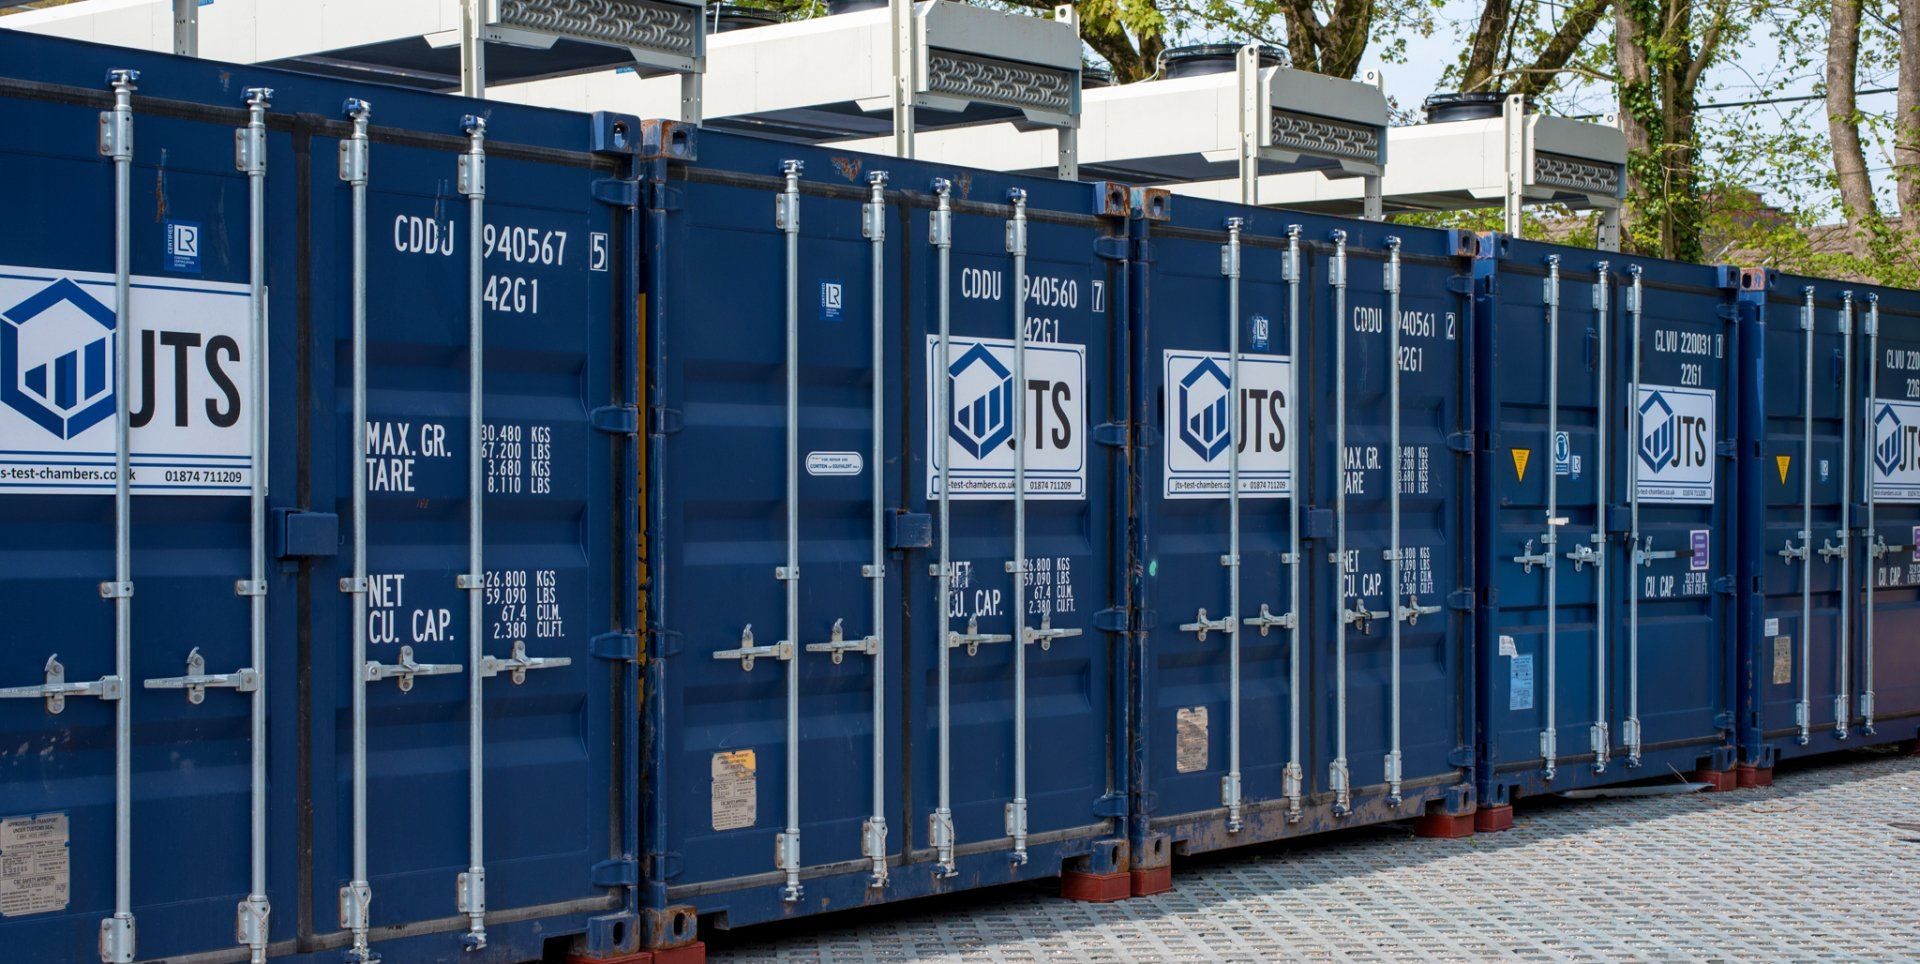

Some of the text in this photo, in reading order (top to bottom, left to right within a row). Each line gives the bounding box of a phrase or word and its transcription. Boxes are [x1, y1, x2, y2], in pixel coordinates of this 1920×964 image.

[177, 227, 196, 254] LR
[483, 224, 567, 266] 940567
[591, 233, 606, 270] 5
[483, 275, 538, 314] 42G1
[962, 267, 1103, 311] CDDU 940560 7
[1354, 306, 1454, 338] CDDU 40561 2
[1655, 330, 1677, 353] CLVU
[1681, 332, 1711, 356] 220031
[1906, 350, 1920, 370] 220
[129, 329, 241, 428] JTS
[1681, 363, 1702, 386] 22G1
[1238, 389, 1286, 454] JTS
[366, 422, 451, 457] MAX. GR.
[531, 426, 550, 443] KGS
[1670, 415, 1706, 468] JTS
[531, 443, 550, 460] LBS
[1366, 447, 1381, 470] GR.
[1899, 425, 1920, 472] JT
[165, 470, 200, 482] 01874
[203, 471, 242, 483] 711209
[366, 458, 415, 492] TARE
[531, 460, 550, 477] KGS
[531, 477, 550, 494] LBS
[1030, 481, 1048, 490] 01874
[1050, 481, 1072, 490] 711209
[1057, 557, 1070, 571] KGS
[536, 570, 555, 587] KGS
[1057, 571, 1070, 585] LBS
[1363, 573, 1383, 597] CAP.
[1660, 575, 1676, 597] CAP.
[369, 574, 404, 607] NET
[536, 587, 555, 603] LBS
[502, 604, 561, 621] 67.4 CU.M.
[975, 590, 1003, 616] CAP.
[369, 609, 454, 644] CU. CAP.
[536, 621, 565, 637] CU.FT.
